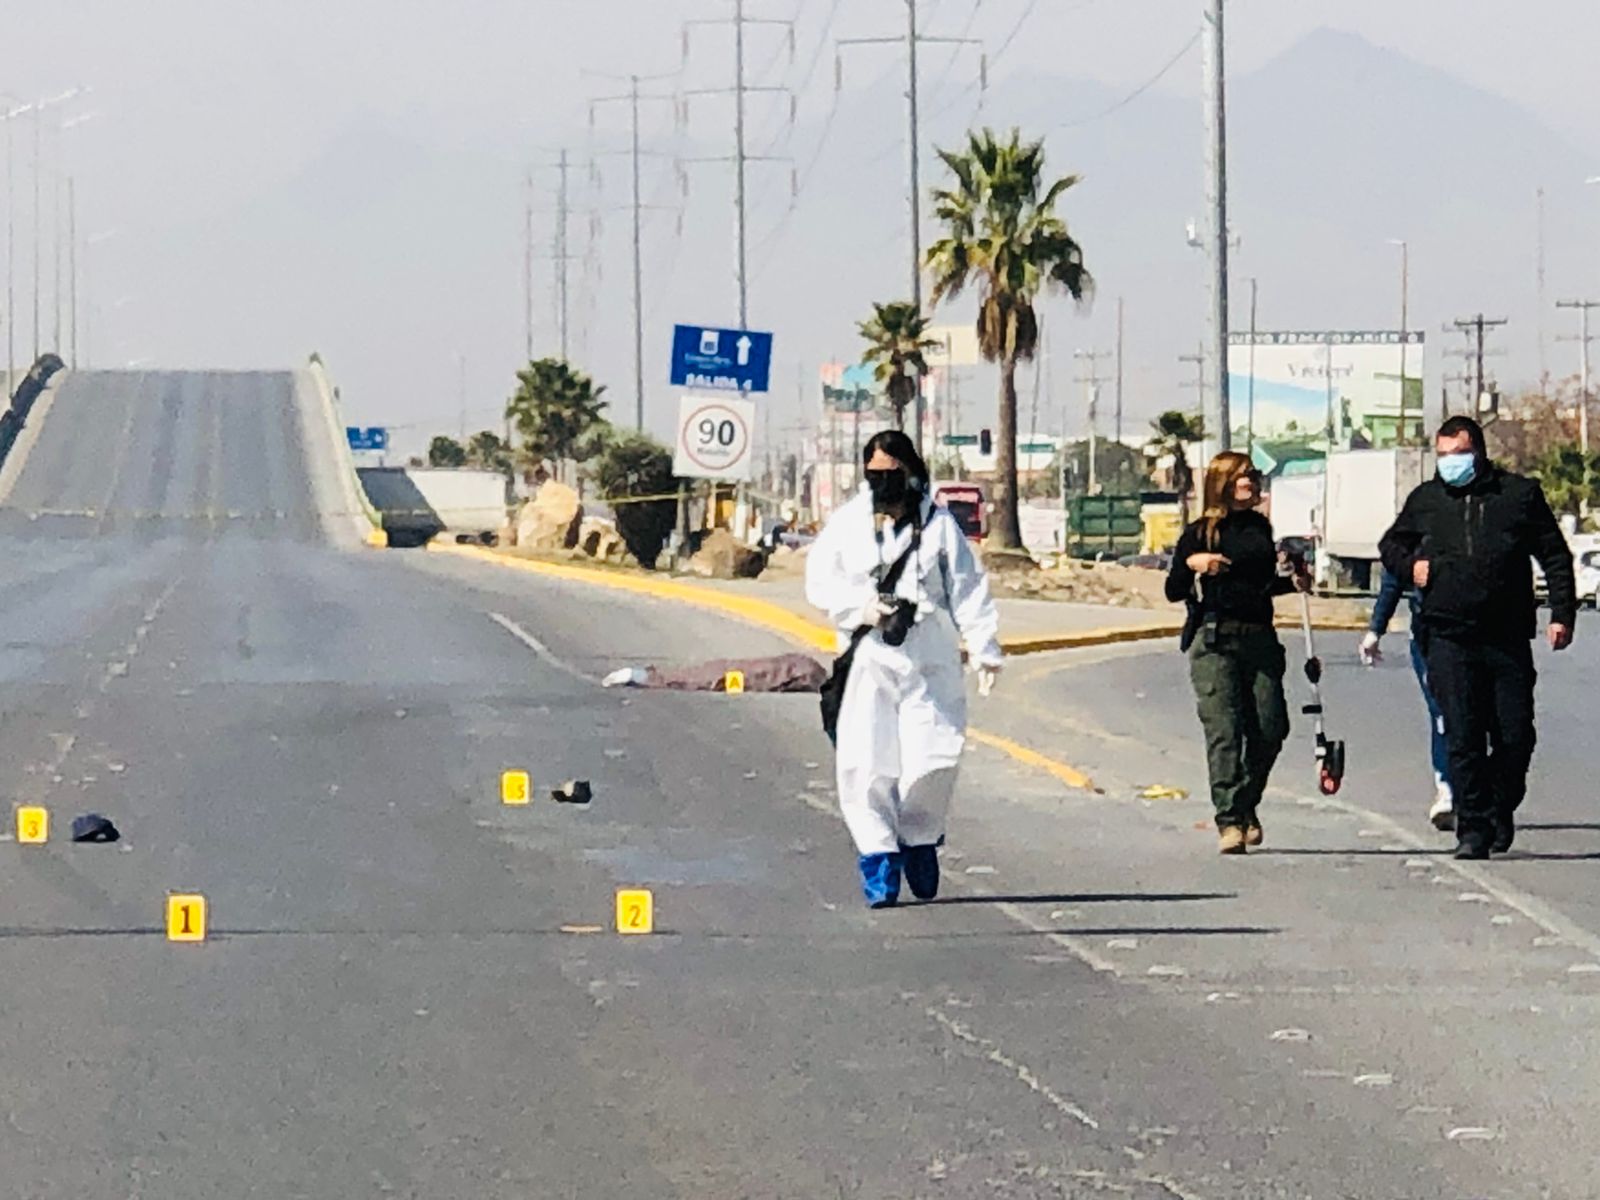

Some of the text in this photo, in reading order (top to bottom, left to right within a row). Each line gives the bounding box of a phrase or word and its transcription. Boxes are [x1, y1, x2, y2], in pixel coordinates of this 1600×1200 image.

[699, 418, 735, 446] 90
[28, 820, 39, 838] 3
[179, 904, 193, 934] 1
[628, 904, 641, 928] 2
